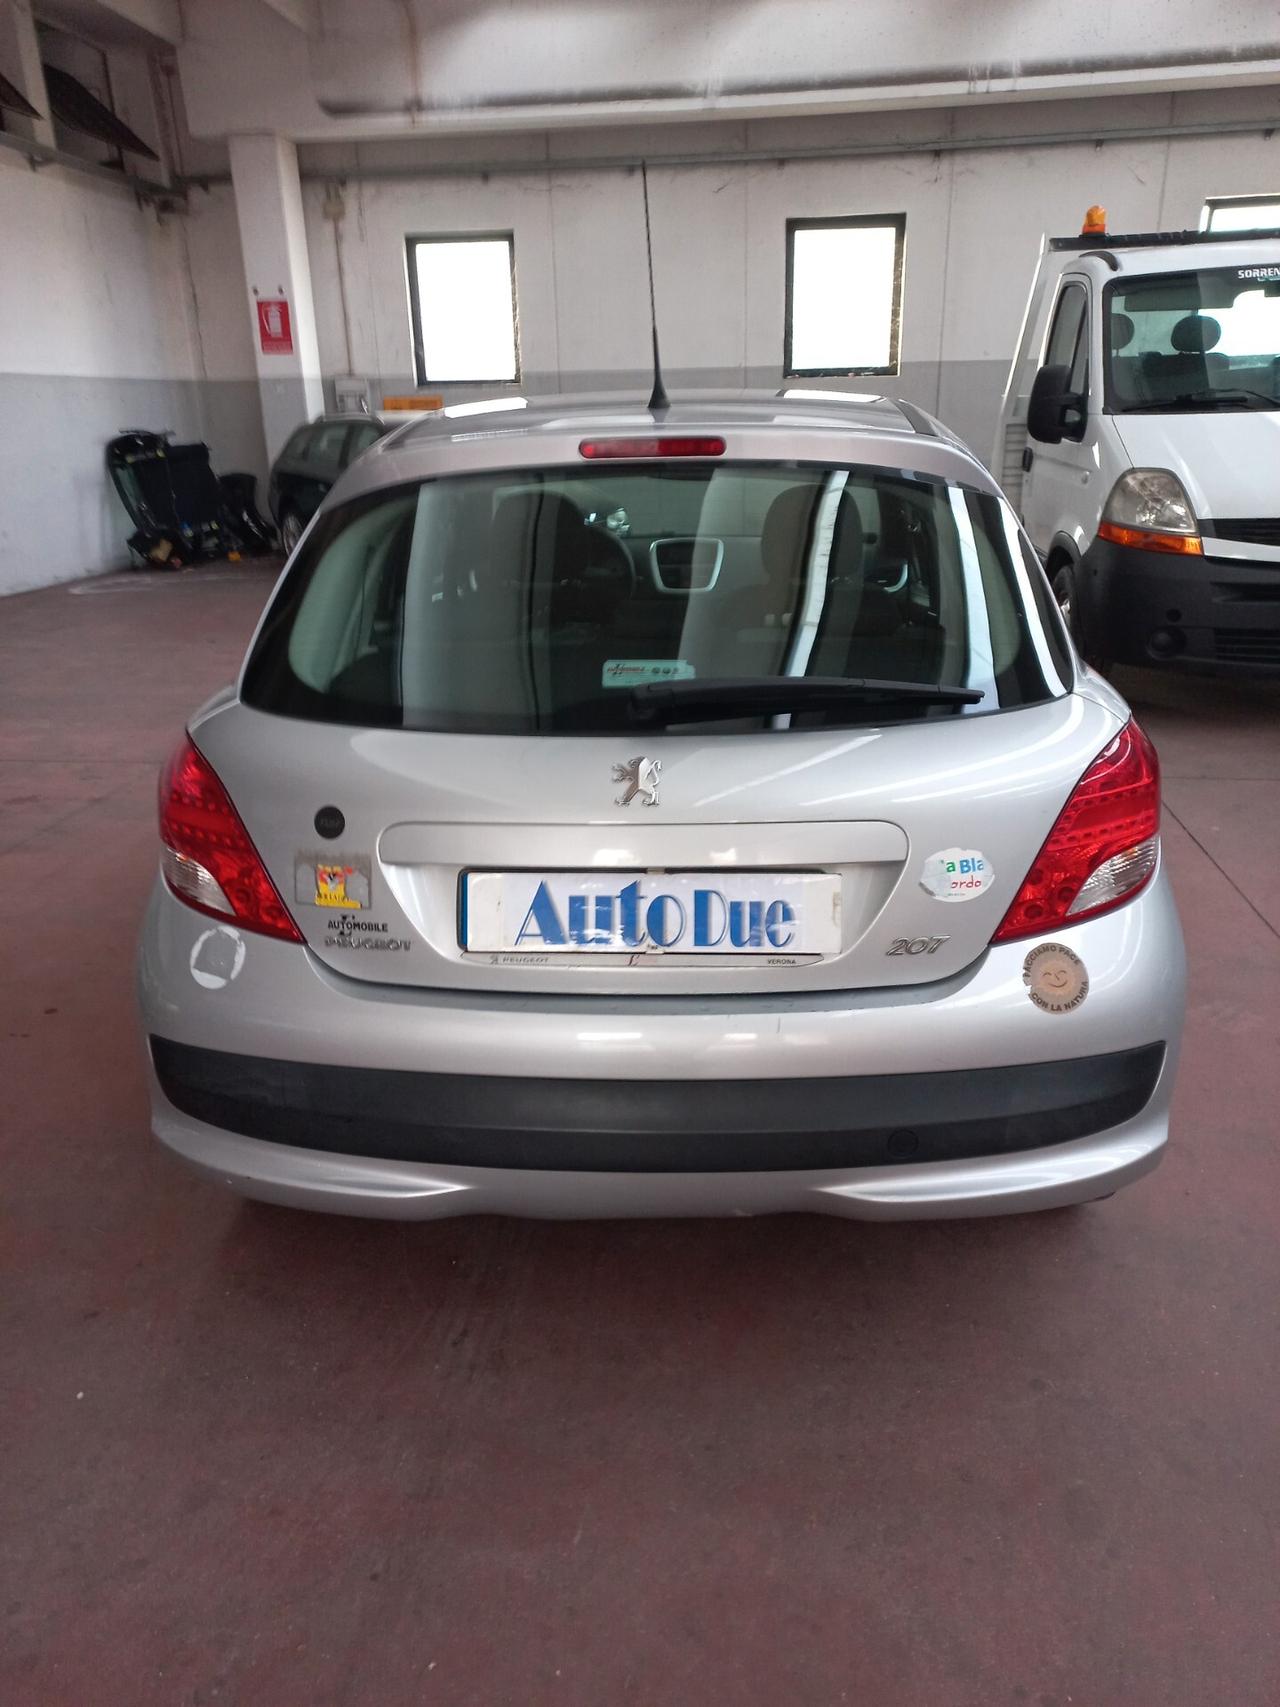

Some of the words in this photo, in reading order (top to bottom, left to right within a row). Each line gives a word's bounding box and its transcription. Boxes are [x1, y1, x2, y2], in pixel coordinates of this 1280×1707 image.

[328, 919, 389, 933] AUTOMOBILE
[886, 935, 952, 956] 207
[1031, 992, 1049, 1009] CON
[1050, 1004, 1062, 1012] LA
